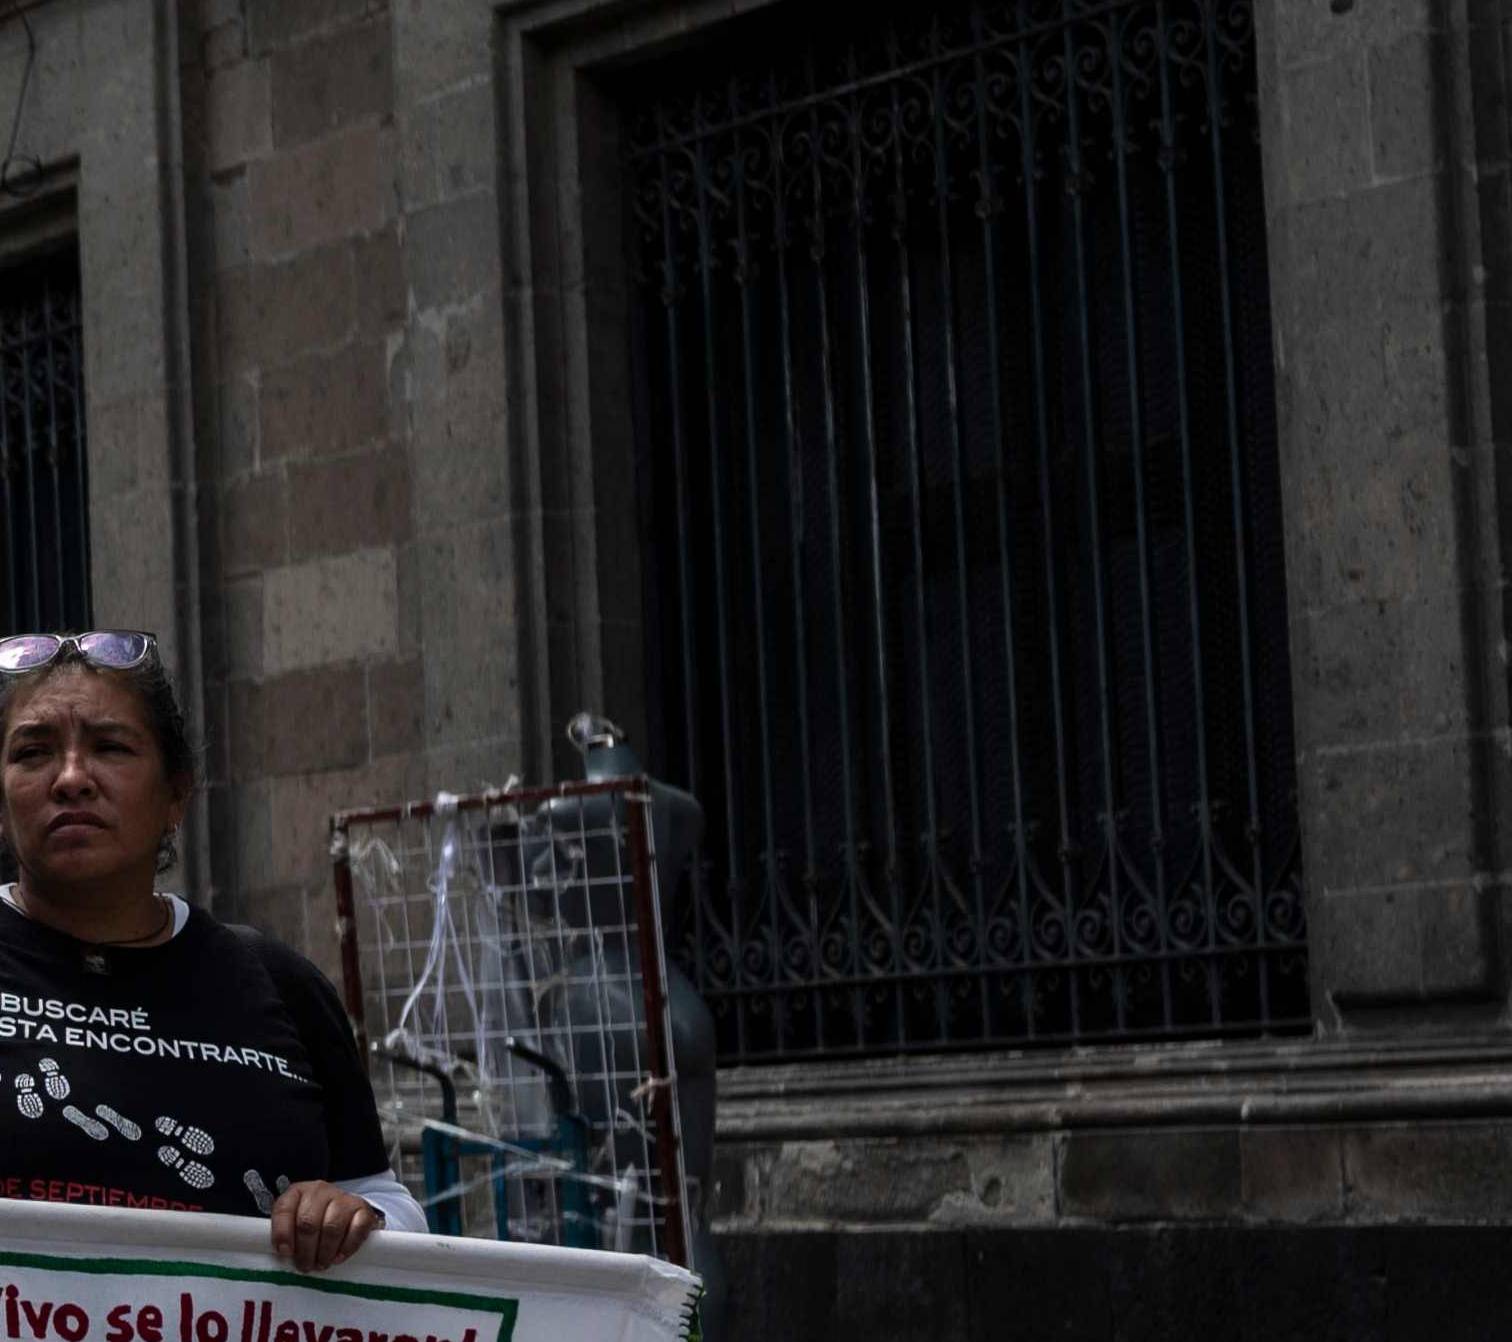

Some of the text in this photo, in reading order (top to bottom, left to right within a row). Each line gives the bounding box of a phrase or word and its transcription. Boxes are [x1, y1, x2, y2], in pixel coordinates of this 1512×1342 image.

[0, 992, 152, 1031] BUSCARÉ
[65, 1027, 310, 1084] ENCONTRARTE...
[26, 1178, 207, 1212] SEPTIEM
